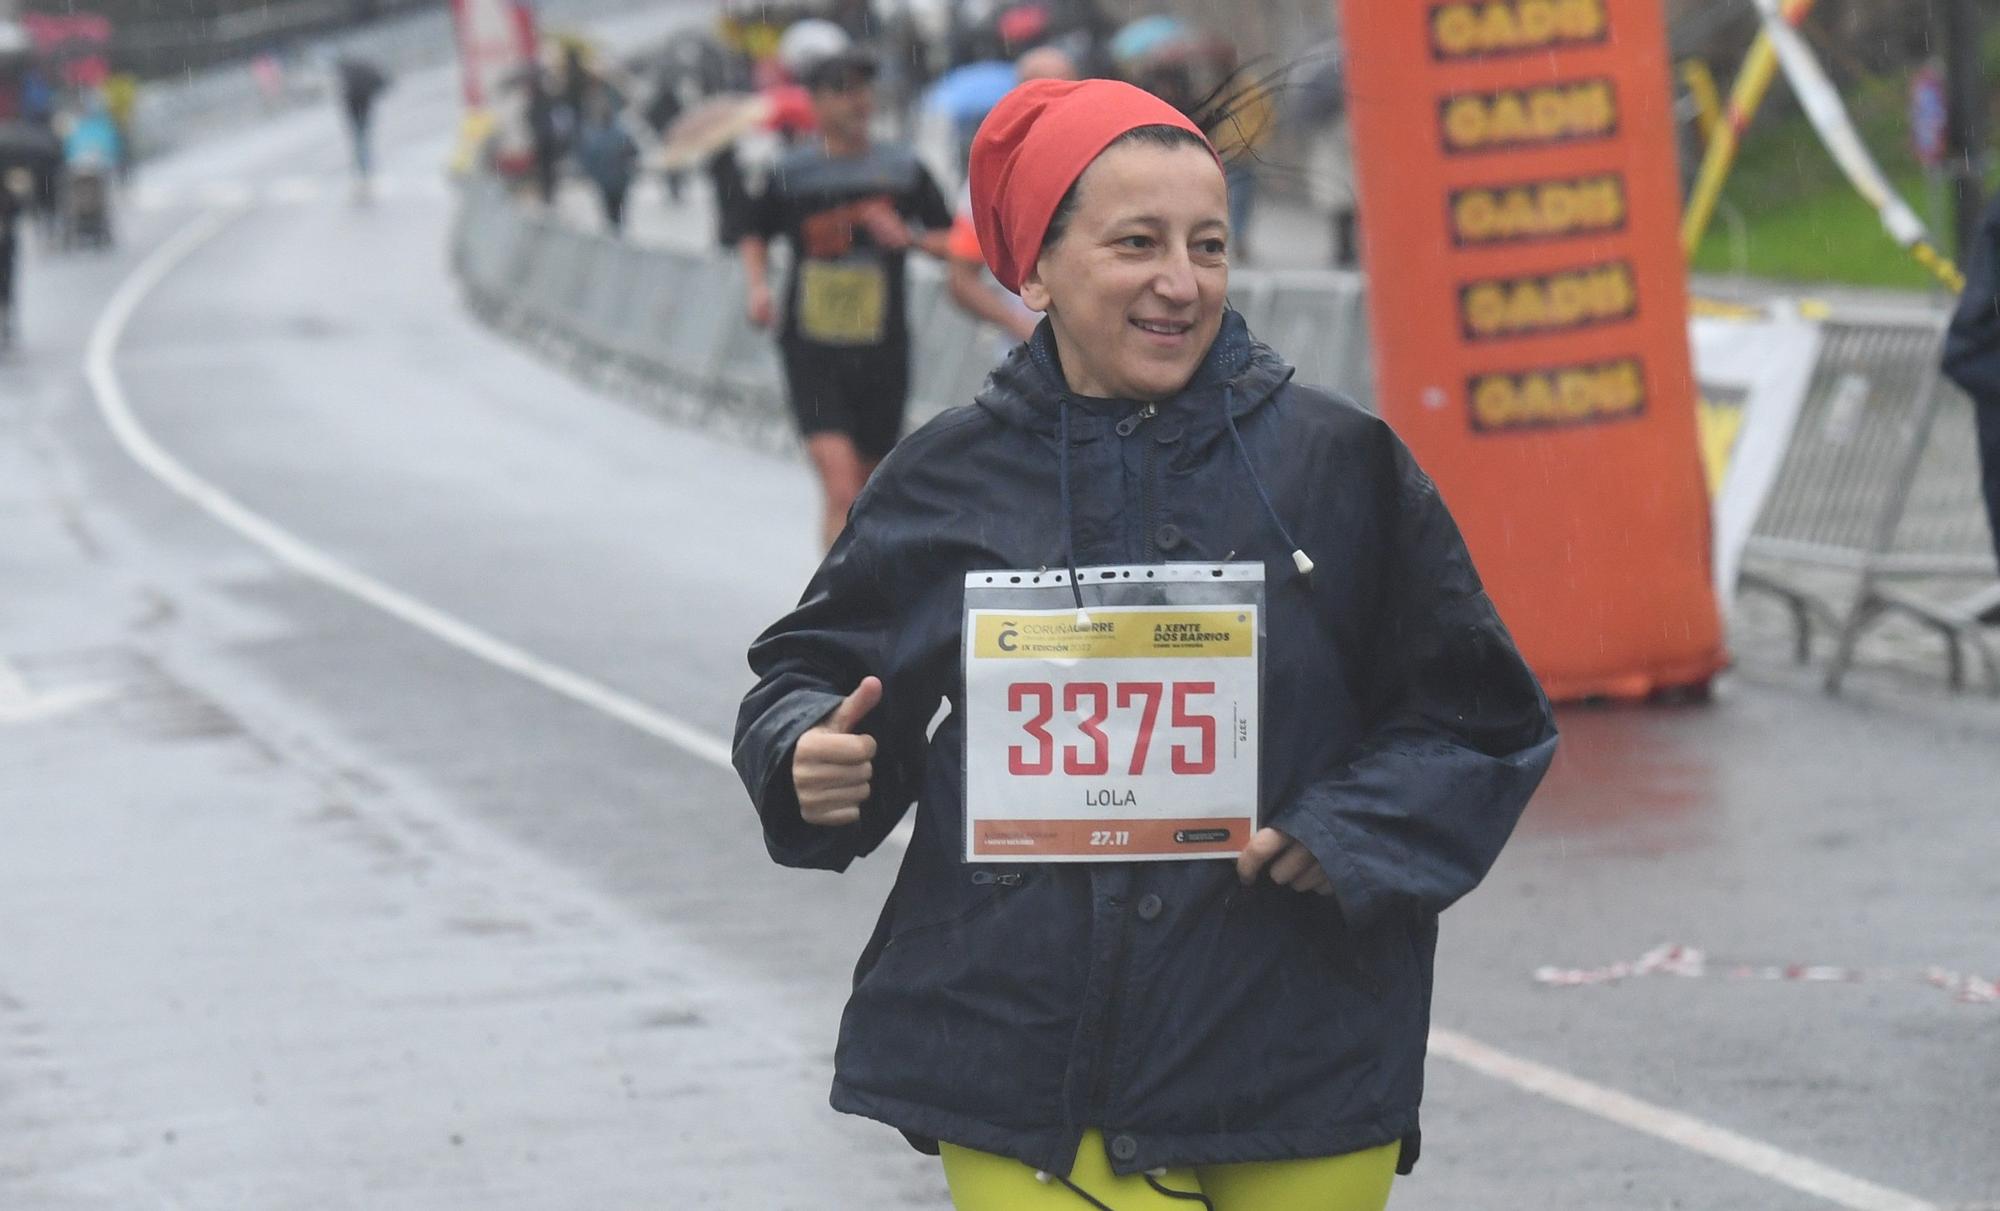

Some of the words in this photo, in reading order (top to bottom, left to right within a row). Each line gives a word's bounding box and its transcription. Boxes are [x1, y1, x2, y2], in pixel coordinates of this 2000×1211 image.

[1154, 623, 1162, 633] A
[1165, 623, 1201, 633] XENTE
[1154, 632, 1178, 642] DOS
[1180, 632, 1230, 642] BARRIOS
[1008, 682, 1216, 775] 3375
[1086, 789, 1137, 806] LOLA
[1089, 831, 1130, 846] 27.11
